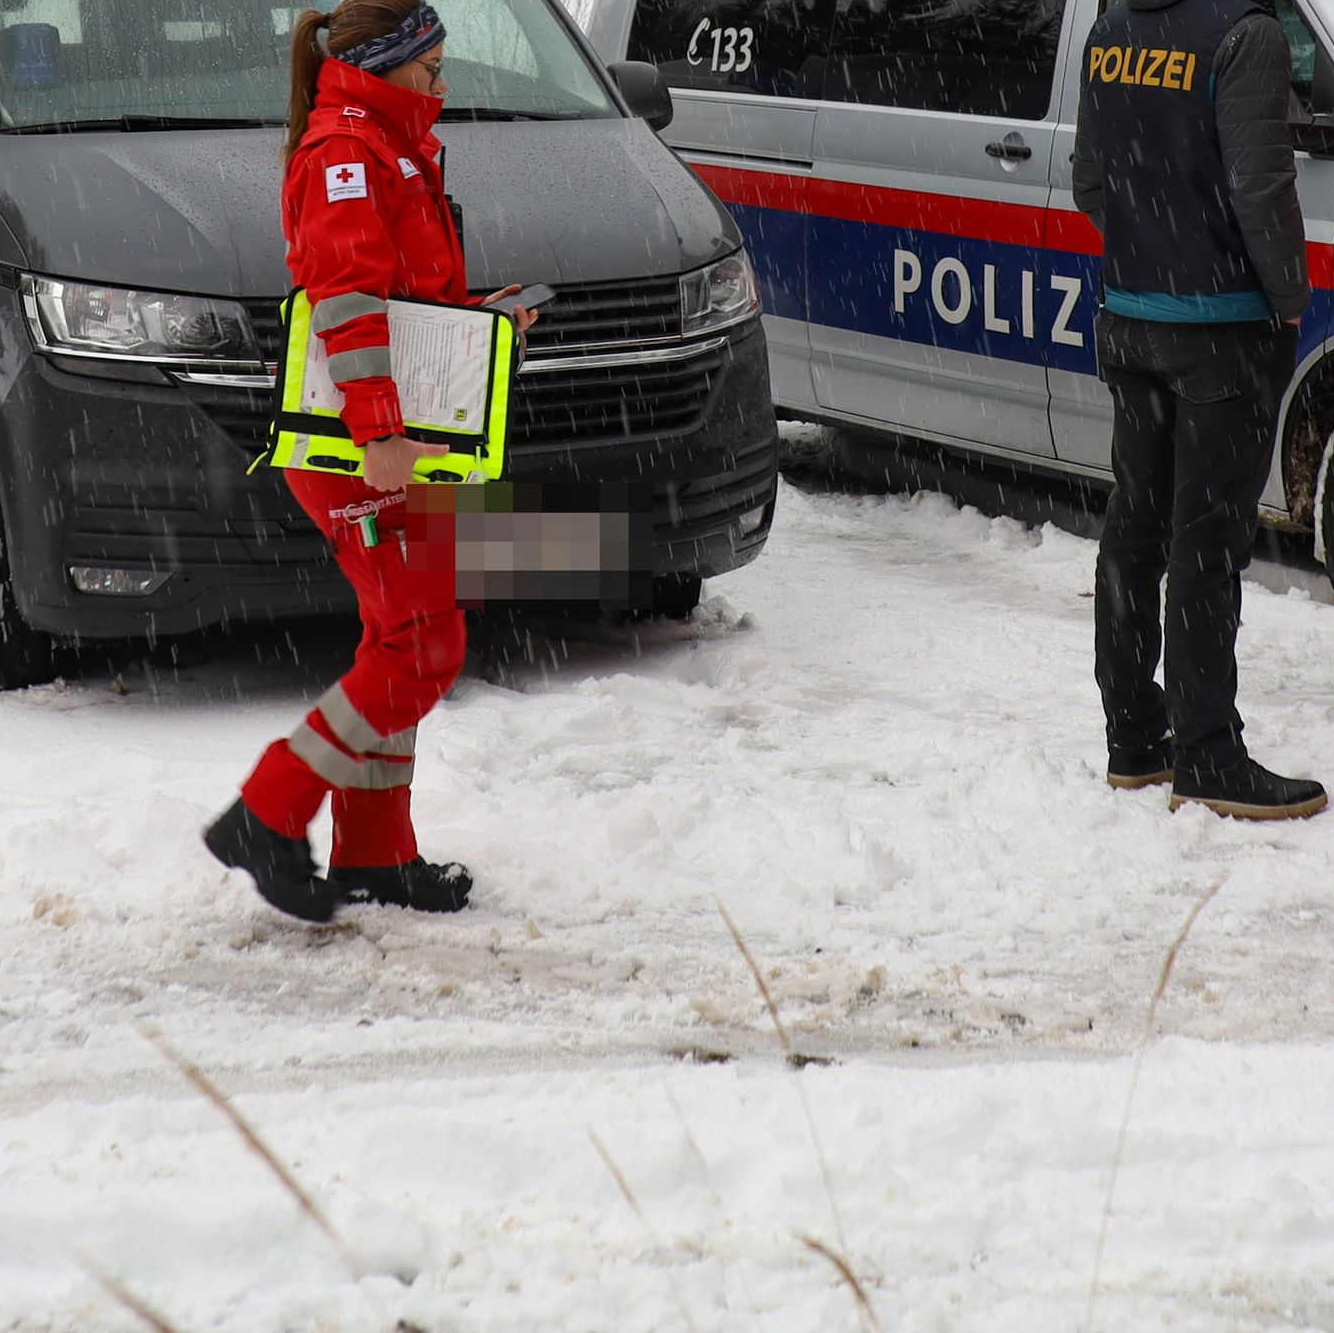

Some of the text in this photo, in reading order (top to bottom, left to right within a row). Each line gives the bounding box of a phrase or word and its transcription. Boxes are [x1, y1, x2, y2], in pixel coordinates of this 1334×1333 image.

[711, 27, 754, 72] 133
[1089, 46, 1196, 91] POLIZEI
[894, 249, 1084, 348] POLIZ
